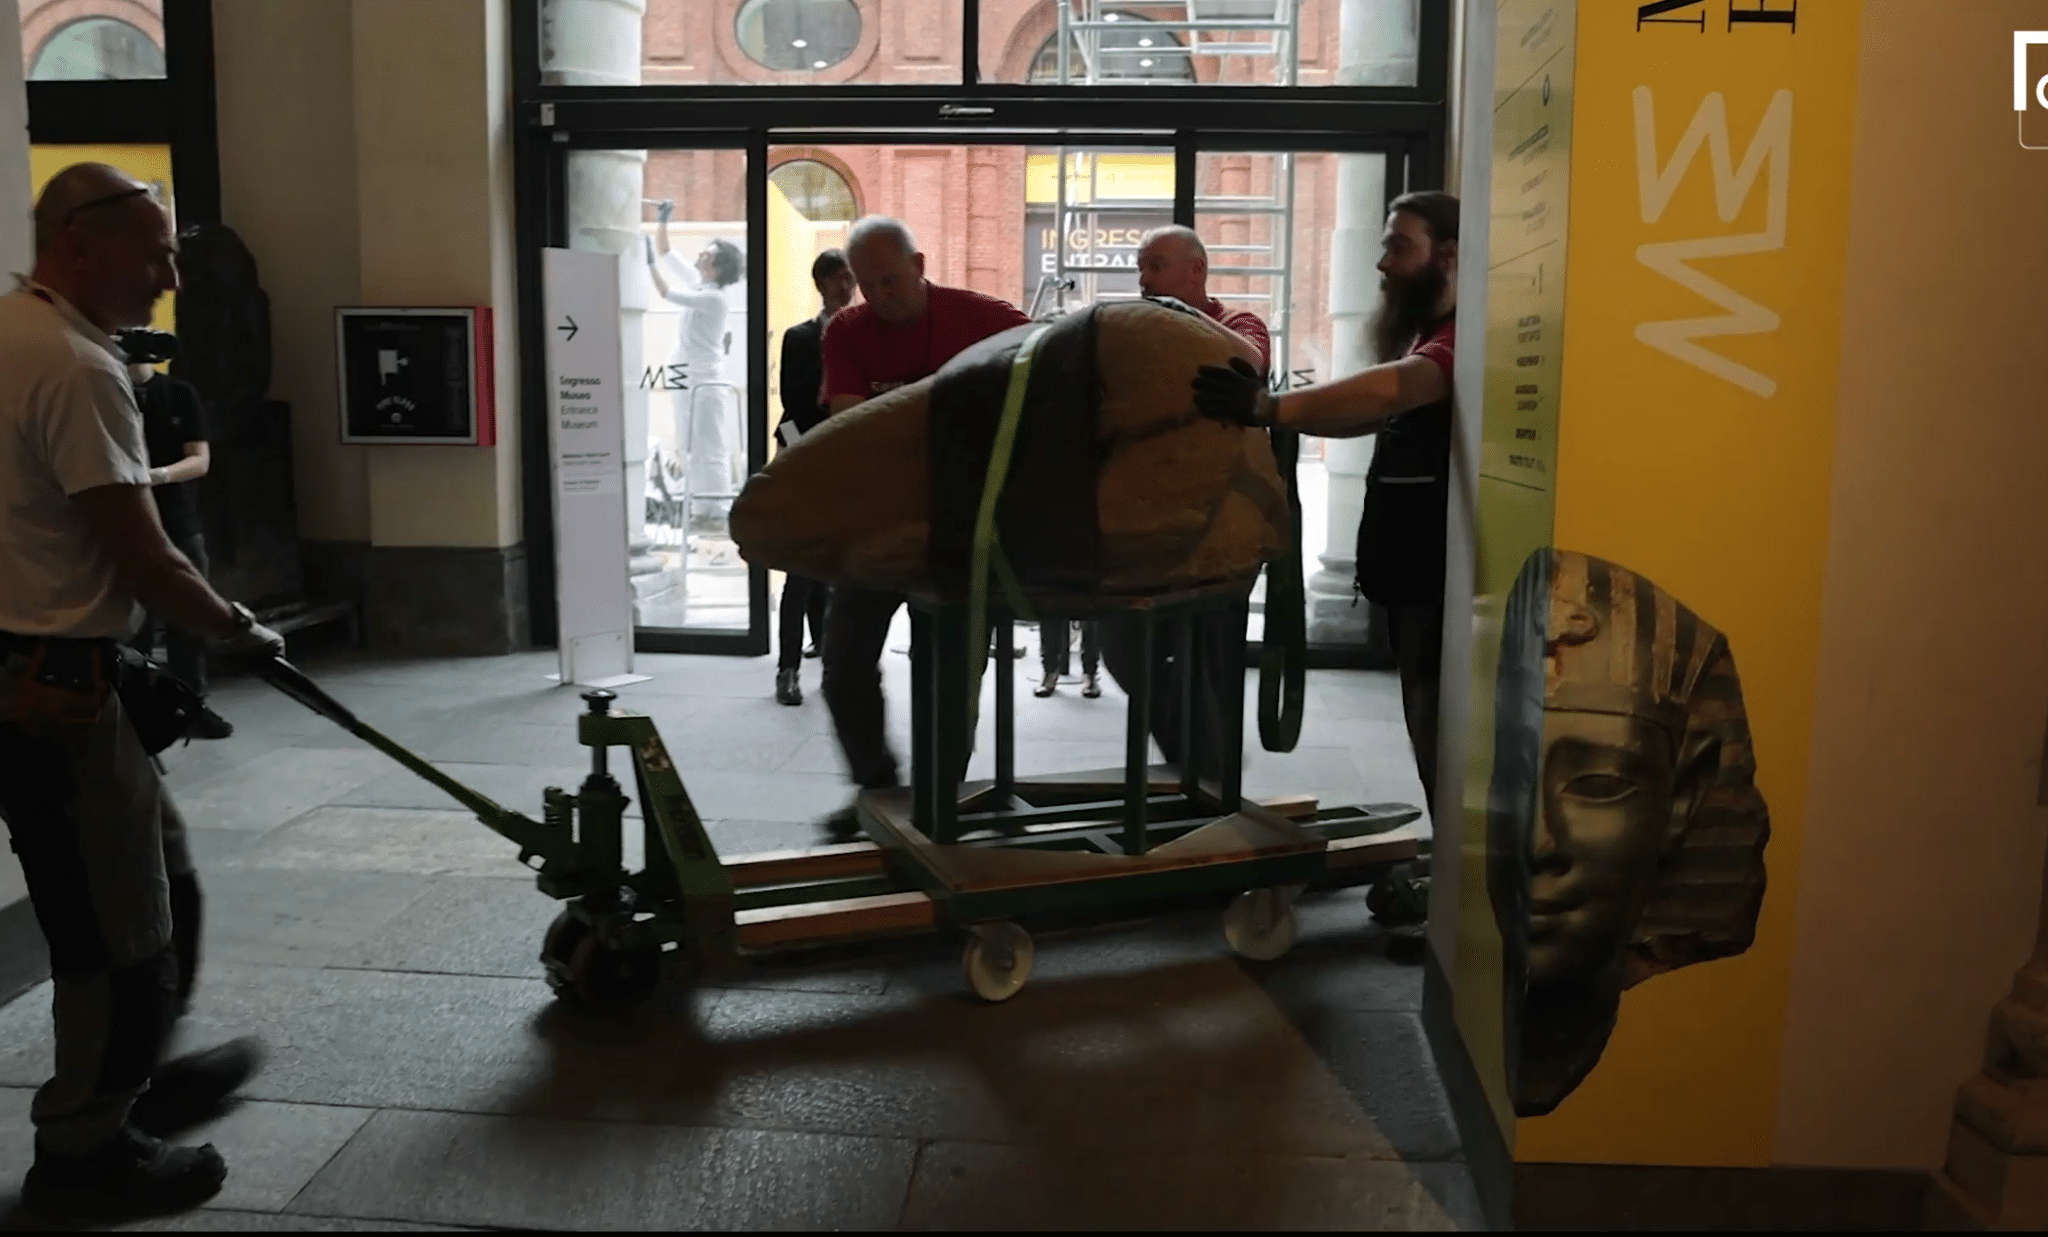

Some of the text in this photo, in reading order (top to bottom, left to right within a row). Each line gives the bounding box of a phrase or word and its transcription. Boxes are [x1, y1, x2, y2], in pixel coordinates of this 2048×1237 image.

[559, 376, 601, 388] Ingresso
[560, 390, 591, 400] Museo
[561, 405, 599, 415] Entrance
[561, 419, 598, 429] Museum
